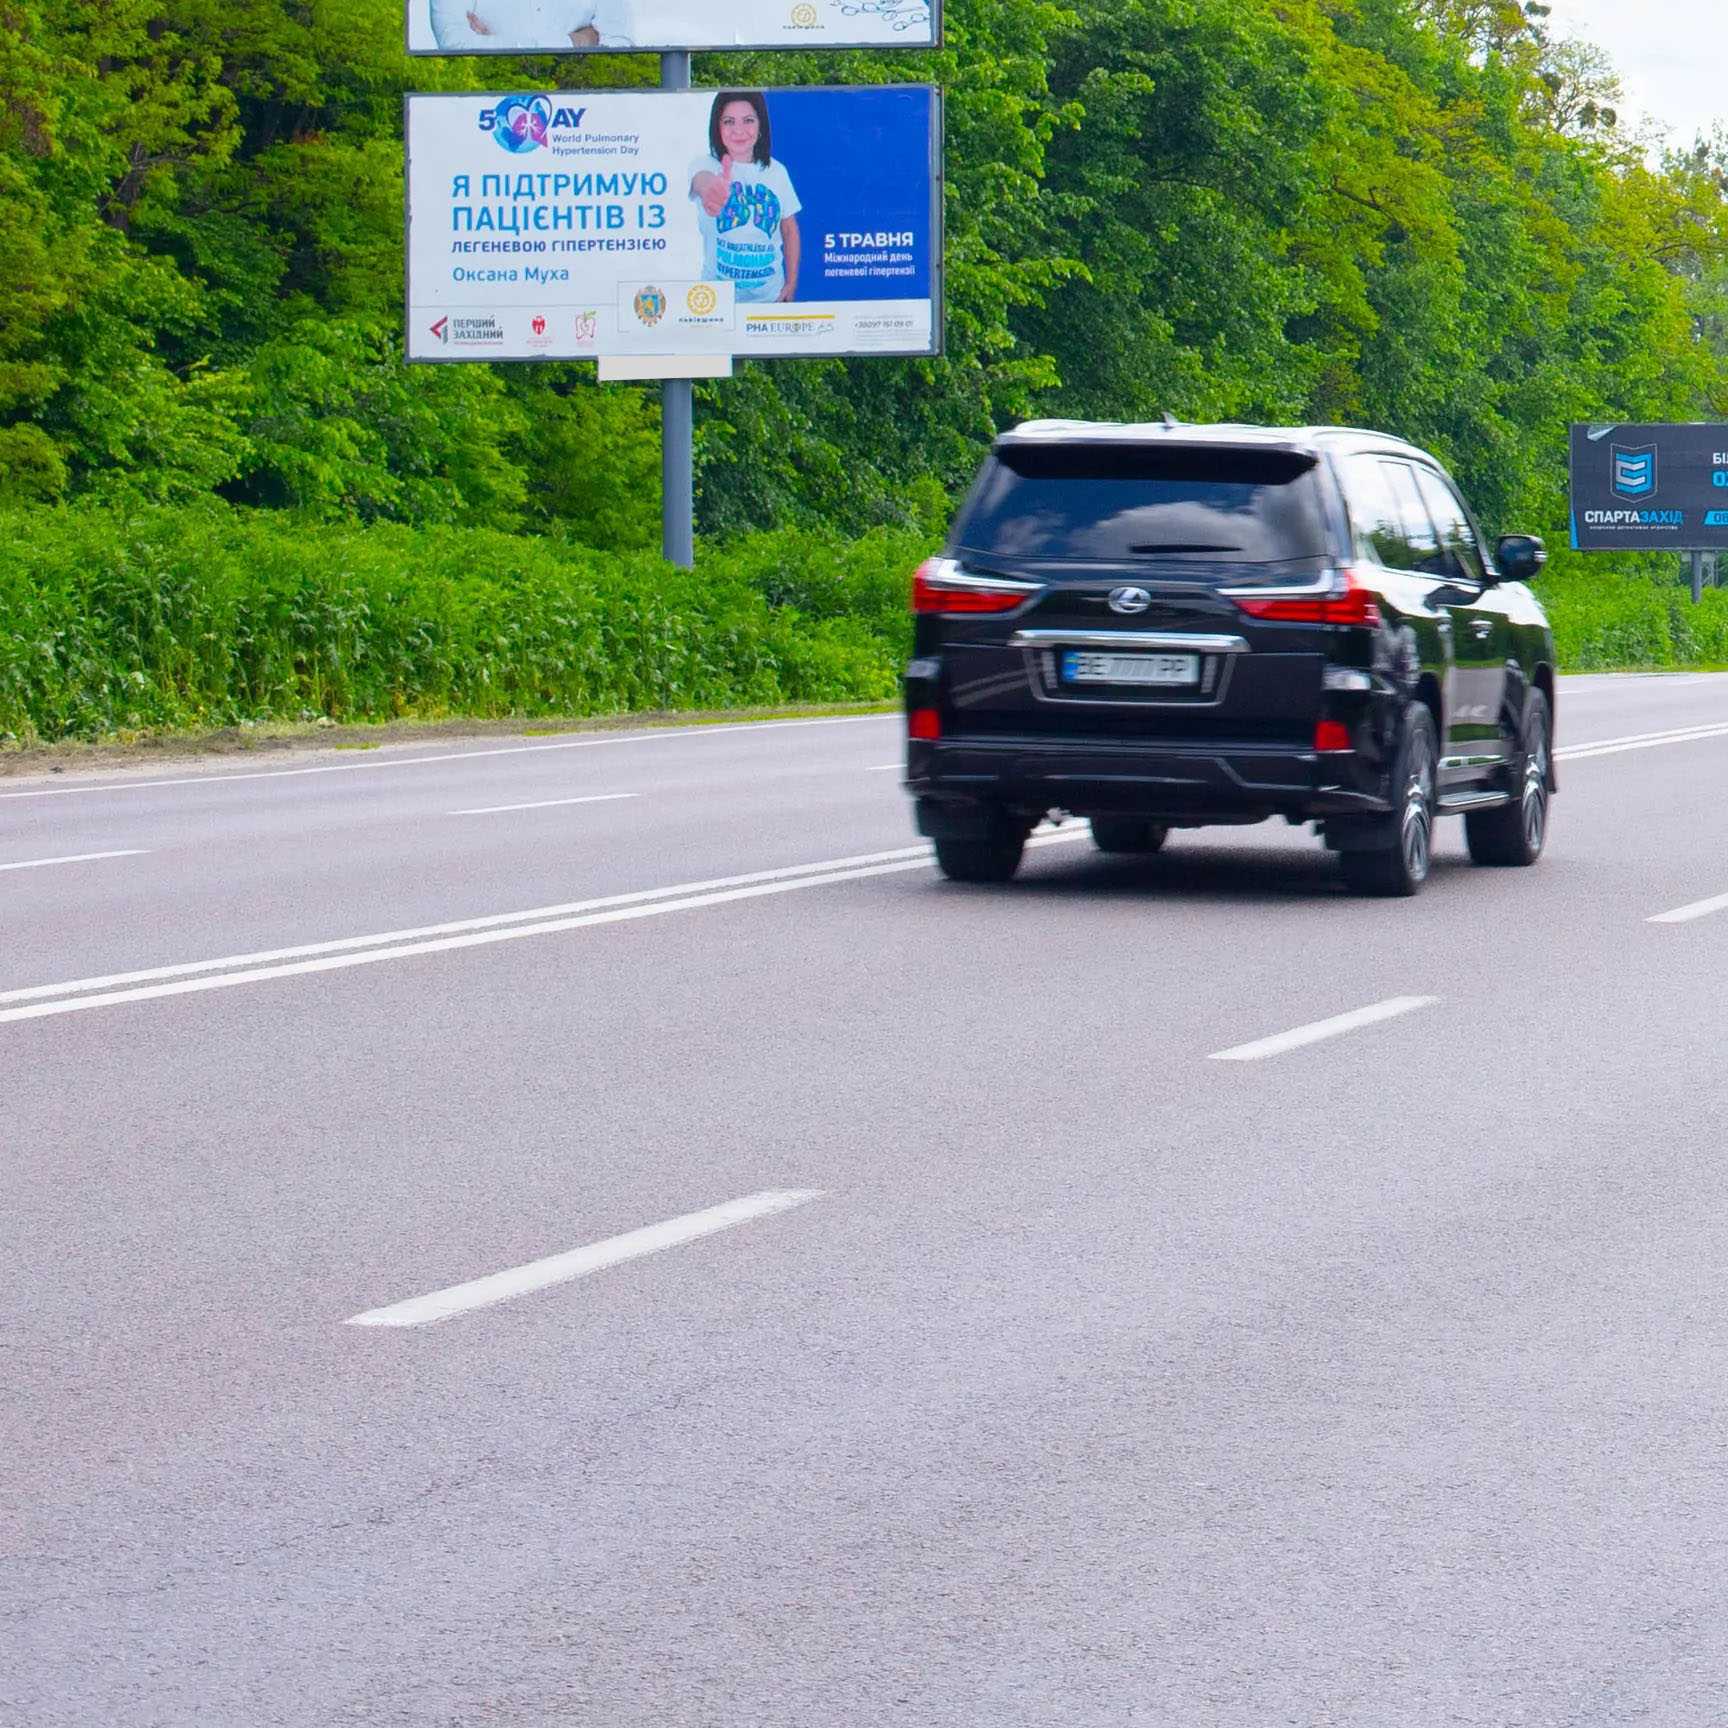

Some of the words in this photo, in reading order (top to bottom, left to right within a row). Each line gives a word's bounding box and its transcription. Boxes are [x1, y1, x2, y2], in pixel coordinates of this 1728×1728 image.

[552, 134, 582, 143] World
[585, 133, 639, 145] Pulmonary
[552, 146, 617, 158] Hypertension
[620, 145, 639, 157] Day
[452, 175, 470, 198] Я
[482, 173, 668, 202] ПІДТРИМУЮ
[452, 205, 625, 236] ПАЦІЄНТІВ
[638, 204, 666, 229] ІЗ
[451, 240, 547, 253] ЛЕГЕНЕВОЮ
[551, 238, 667, 252] ГІПЕРТЕНЗІЄЮ
[824, 235, 836, 248] 5
[839, 232, 913, 247] ТРАВНЯ
[824, 251, 888, 265] Міжнародний
[889, 253, 912, 263] день
[452, 267, 518, 282] Оксана
[525, 266, 569, 284] Муха
[824, 266, 868, 277] легеневої
[868, 264, 915, 278] гіпертензії
[453, 314, 495, 328] ПЕРШИЙ
[746, 324, 768, 332] PHA
[454, 326, 503, 339] ЗАХІДНИЙ
